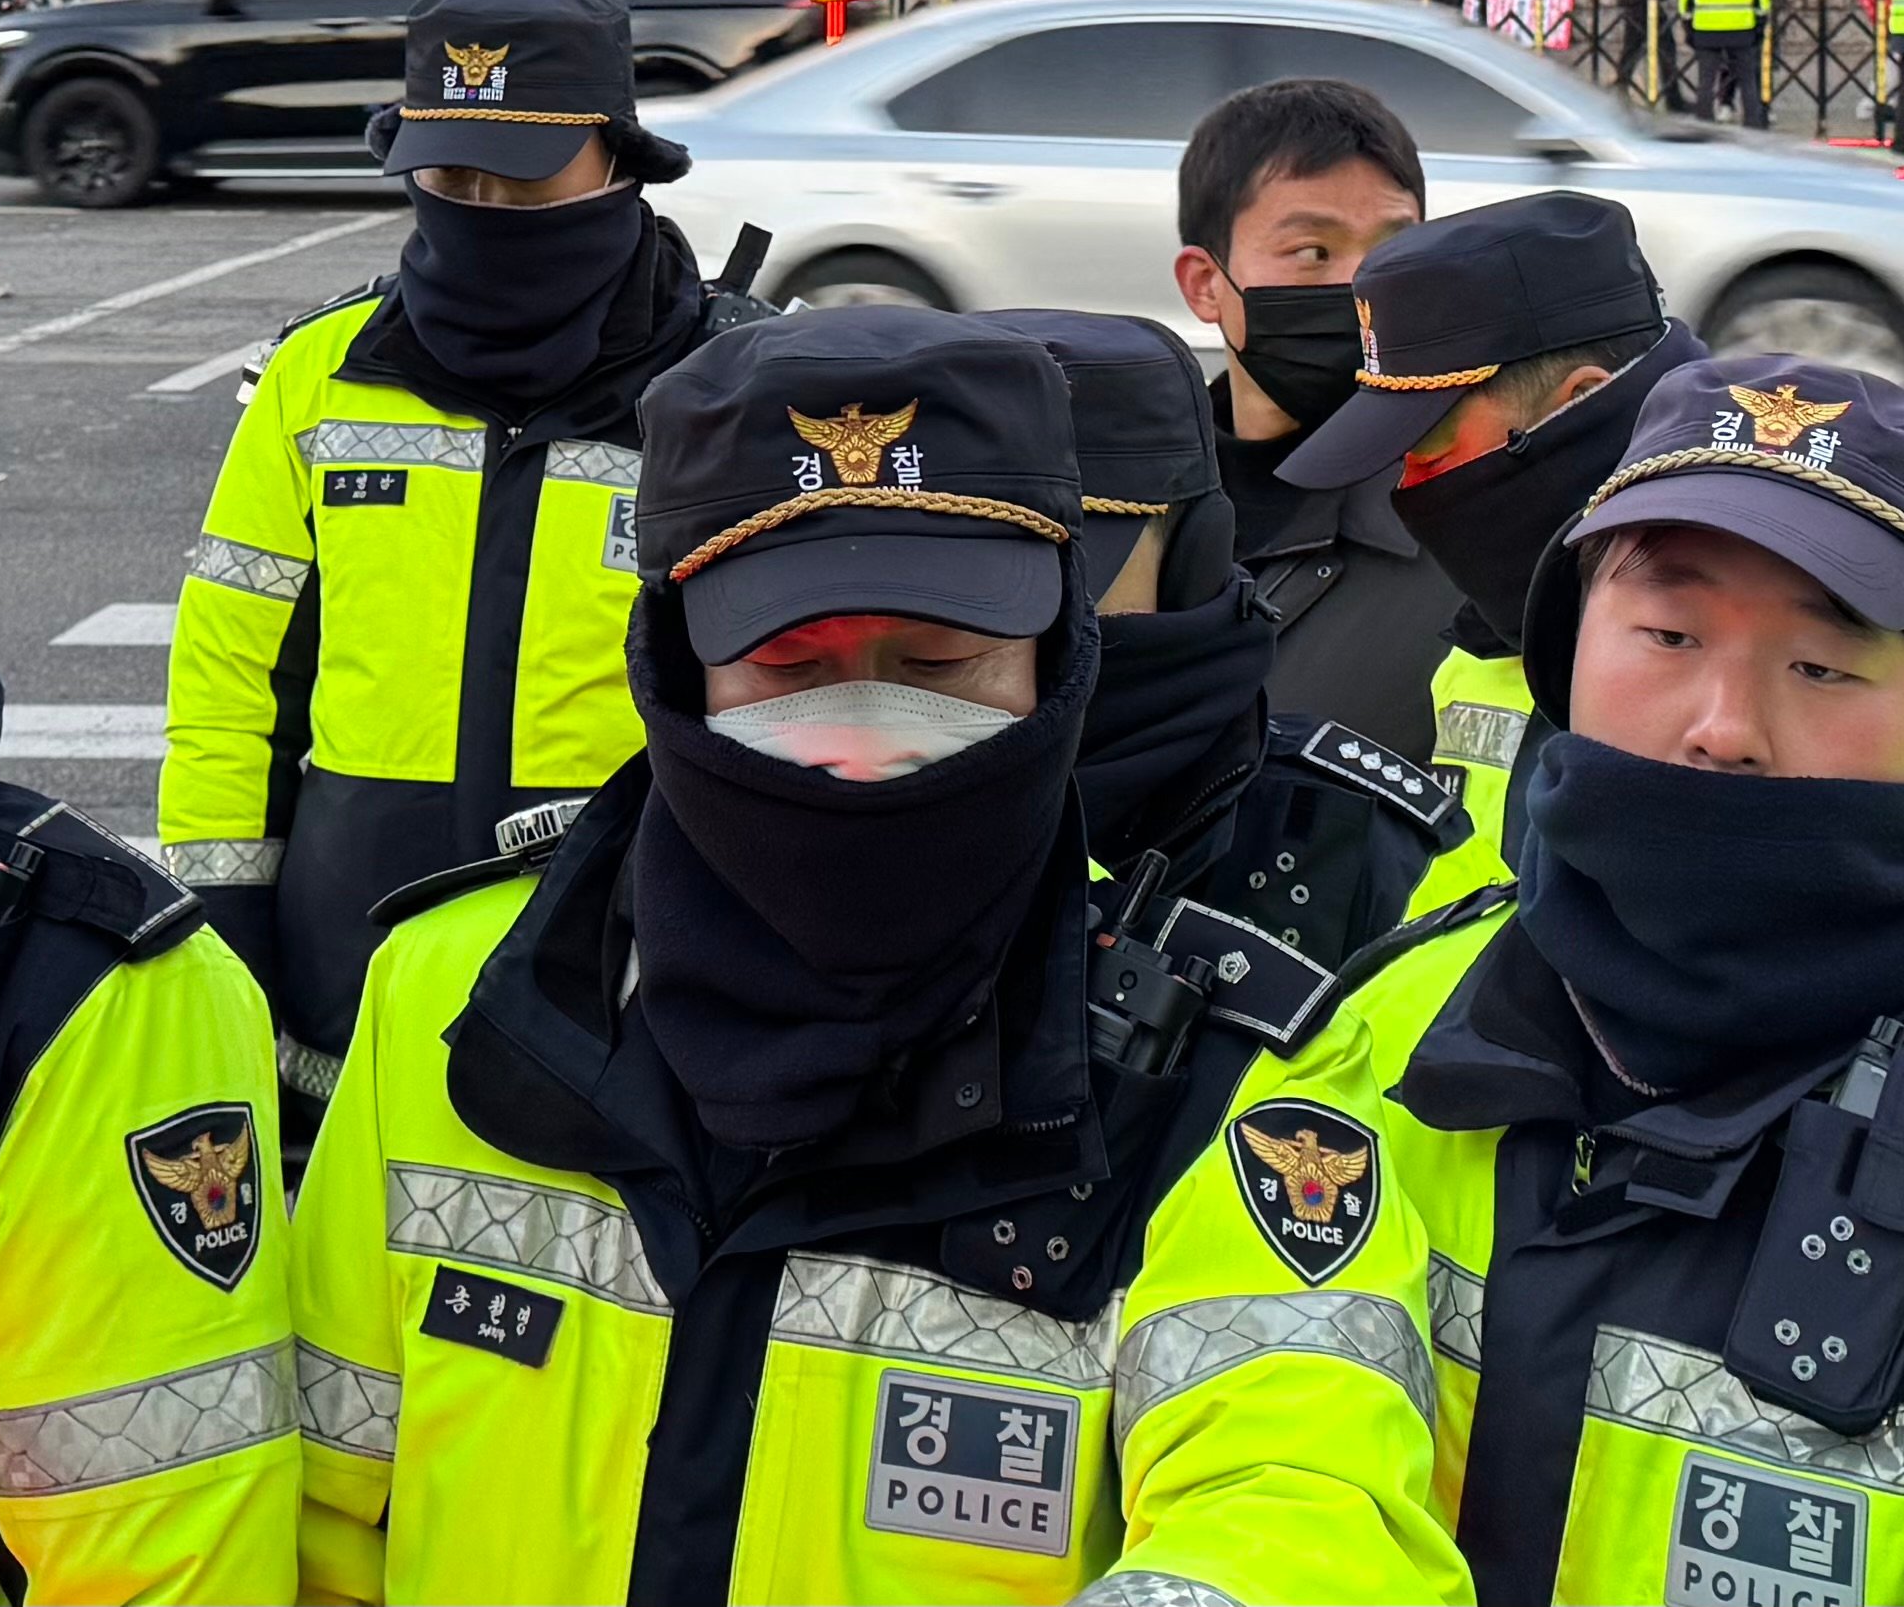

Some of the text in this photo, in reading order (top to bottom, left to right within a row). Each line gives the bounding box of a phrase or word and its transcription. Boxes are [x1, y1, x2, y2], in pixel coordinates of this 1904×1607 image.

[194, 1221, 249, 1252] POLICE
[1282, 1217, 1345, 1246] POLICE
[898, 1393, 1054, 1485] 경찰
[887, 1479, 1050, 1535] POLICE
[1695, 1474, 1843, 1578] 경찰
